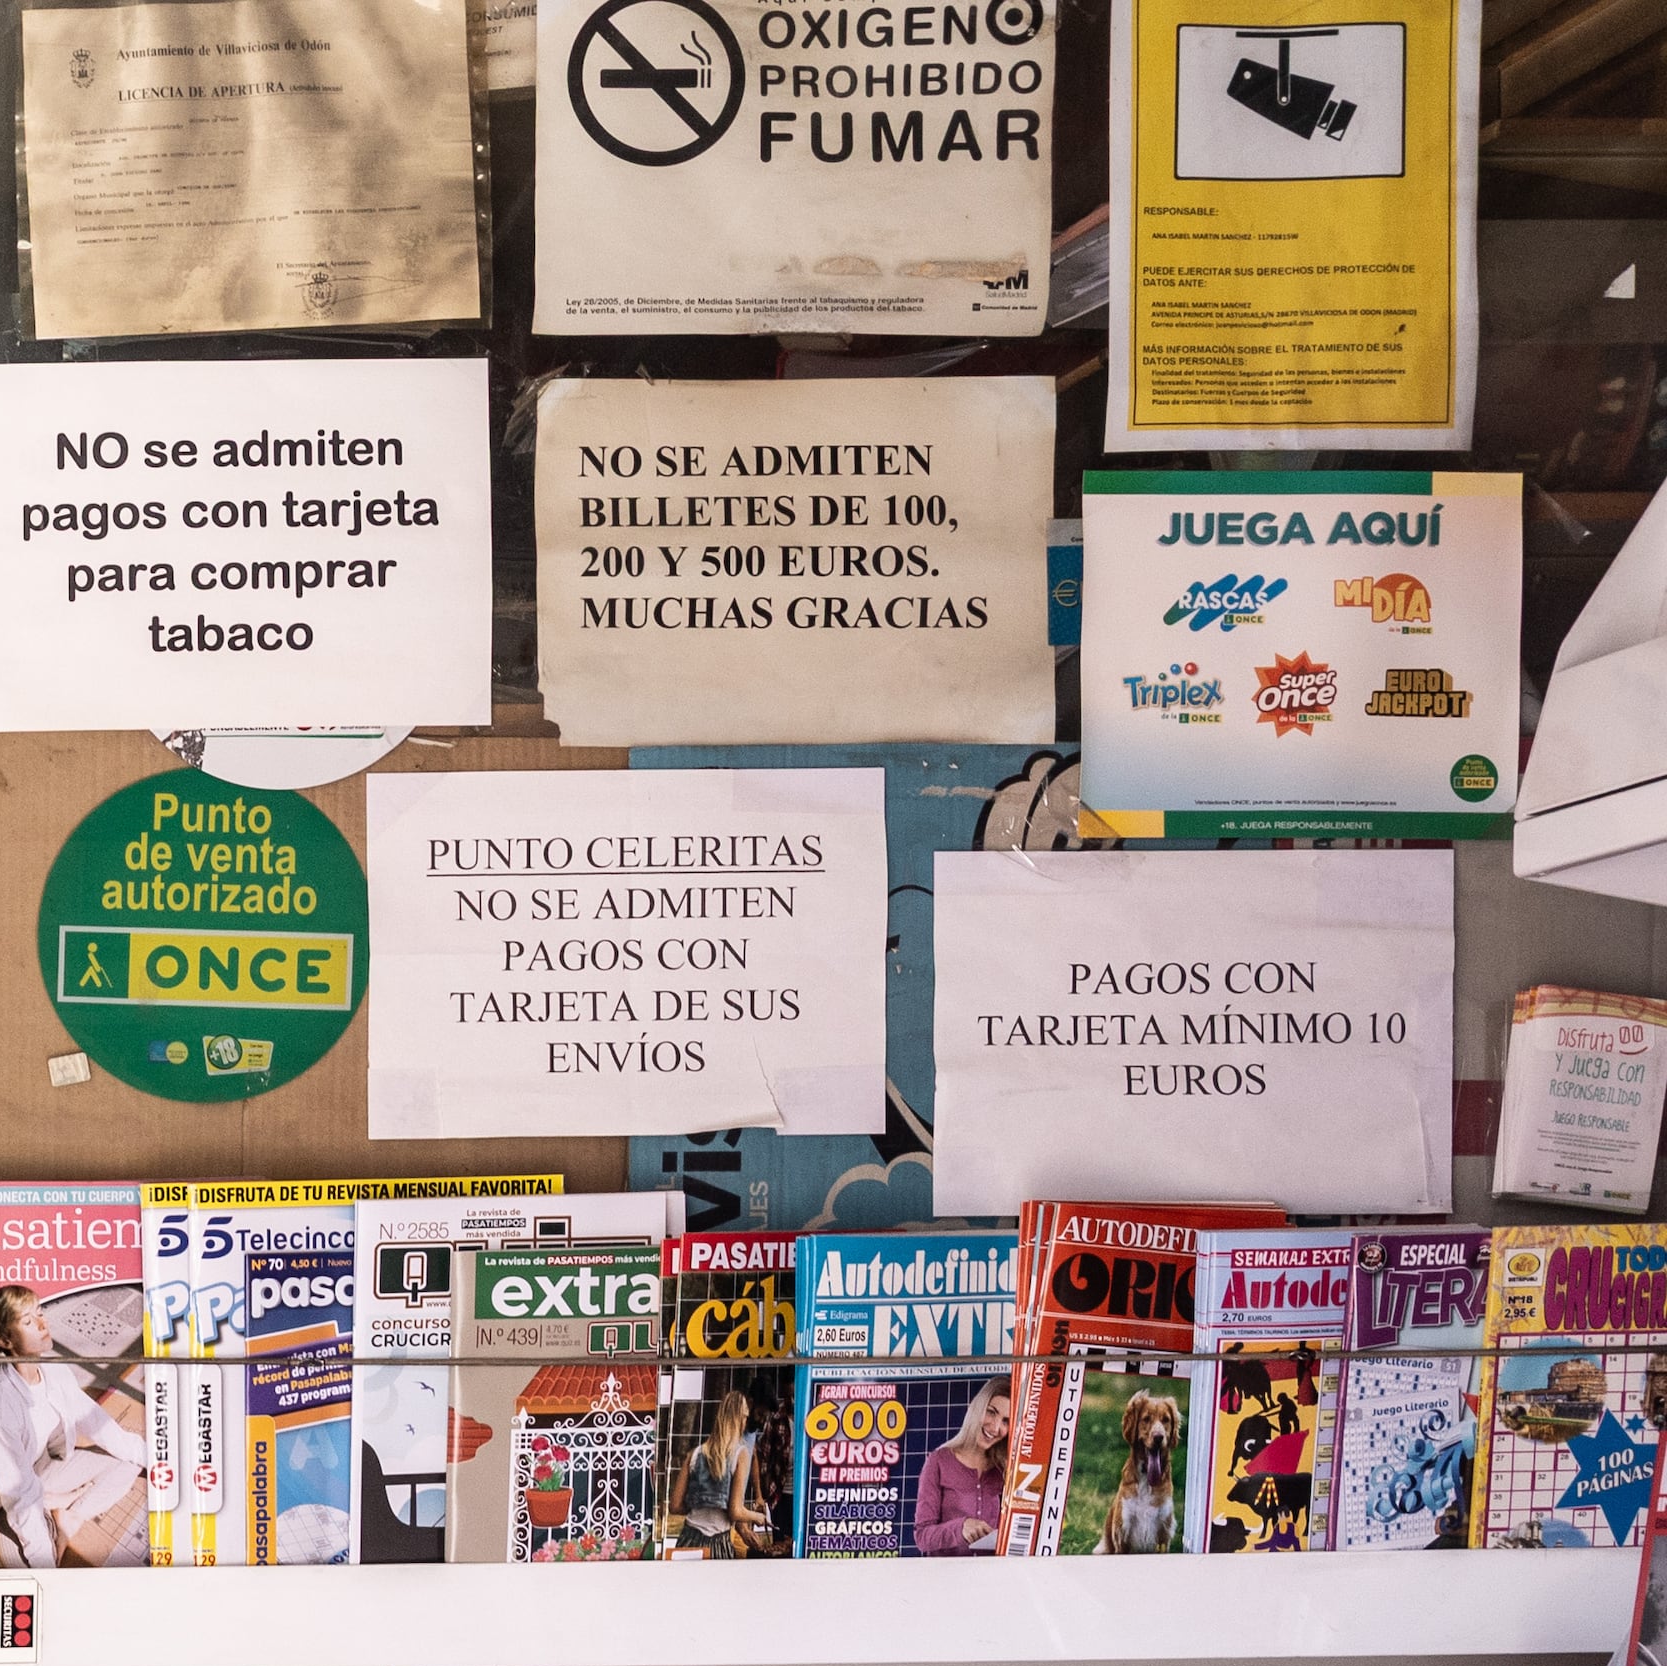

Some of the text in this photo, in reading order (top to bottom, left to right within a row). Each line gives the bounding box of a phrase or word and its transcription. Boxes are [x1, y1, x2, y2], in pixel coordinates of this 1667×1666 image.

[119, 82, 285, 102] LICENCIA DE APERTURA
[760, 60, 1042, 99] PROHIBIDO
[761, 109, 1040, 163] FUMAR
[1144, 206, 1218, 216] RESPONSABLE:
[57, 429, 402, 469] NO se admiten
[579, 445, 932, 477] NO SE ADMITEN
[23, 489, 439, 541] pagos con tarjeta
[581, 495, 957, 532] BILLETES DE 100,
[1158, 503, 1443, 547] JUEGA AQUÍ
[581, 545, 939, 577] 200 Y 500 EUROS.
[69, 560, 397, 602] para comprar
[582, 596, 987, 629] MUCHAS GRACIAS
[1178, 589, 1268, 610] RASCAS
[148, 614, 313, 652] tabaco
[154, 794, 271, 834] Punto
[125, 832, 296, 875] de venta
[430, 835, 822, 870] PUNTO CELERITAS
[102, 874, 316, 915] autorizado
[455, 887, 795, 920] NO SE ADMITEN
[146, 945, 331, 994] ONCE
[505, 939, 747, 972] PAGOS CON
[1071, 962, 1315, 995] PAGOS CON
[450, 989, 799, 1022] TARJETA DE SUS
[978, 1003, 1405, 1046] TARJETA MÍNIMO 10
[549, 1032, 705, 1073] ENVÍOS
[1125, 1063, 1265, 1096] EUROS
[281, 1187, 298, 1201] DE
[304, 1186, 322, 1201] TU
[328, 1184, 389, 1200] REVISTA
[394, 1181, 467, 1198] MENSUAL
[471, 1178, 552, 1196] FAVORITA!
[1400, 1242, 1466, 1267] ESPECIAL
[806, 1408, 907, 1439] 600
[1599, 1448, 1638, 1474] 100
[1573, 1459, 1657, 1500] PÁGINAS
